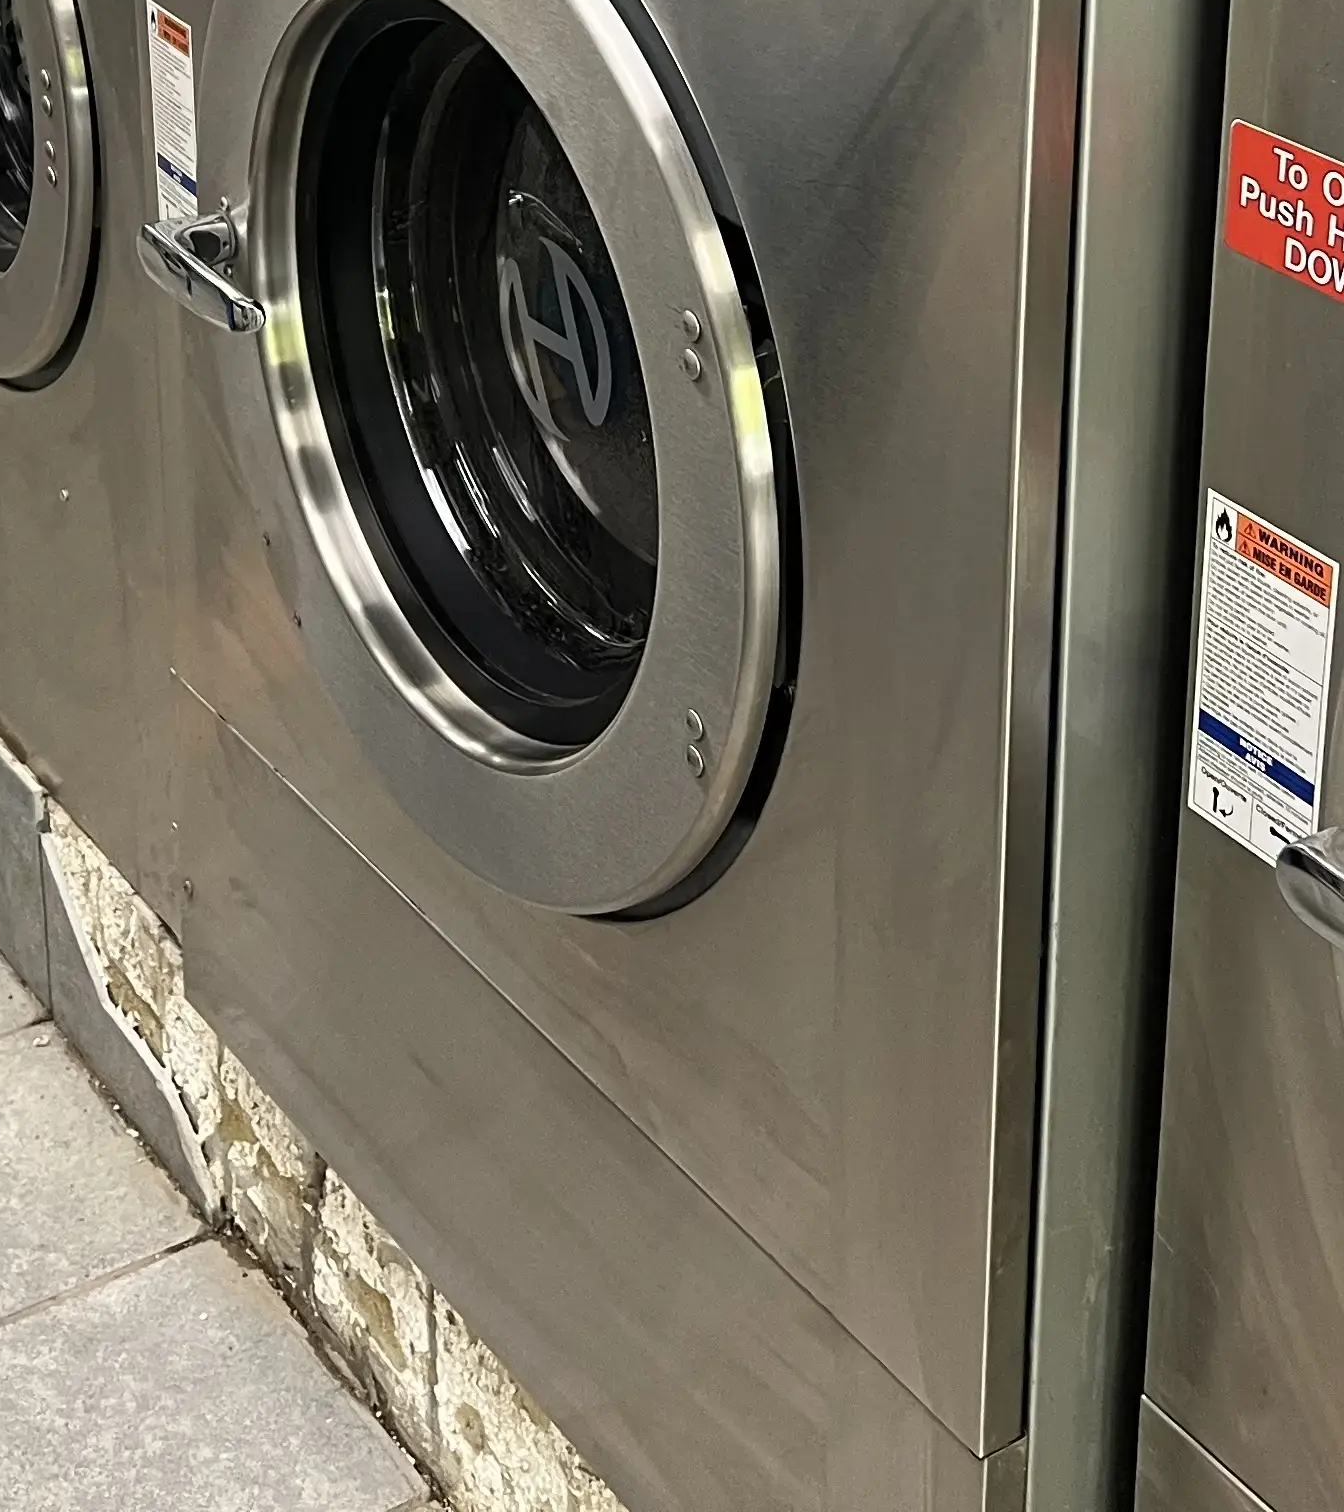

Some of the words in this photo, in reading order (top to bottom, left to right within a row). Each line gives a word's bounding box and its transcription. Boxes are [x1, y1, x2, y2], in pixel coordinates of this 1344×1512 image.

[1273, 147, 1309, 190] To
[1239, 175, 1315, 237] Push
[1252, 546, 1277, 571] MISE
[1278, 561, 1292, 581] EN
[1293, 571, 1327, 603] GARDE
[1258, 528, 1325, 579] WARNING
[1239, 736, 1274, 767] NOTICE
[1244, 752, 1266, 772] AVIS
